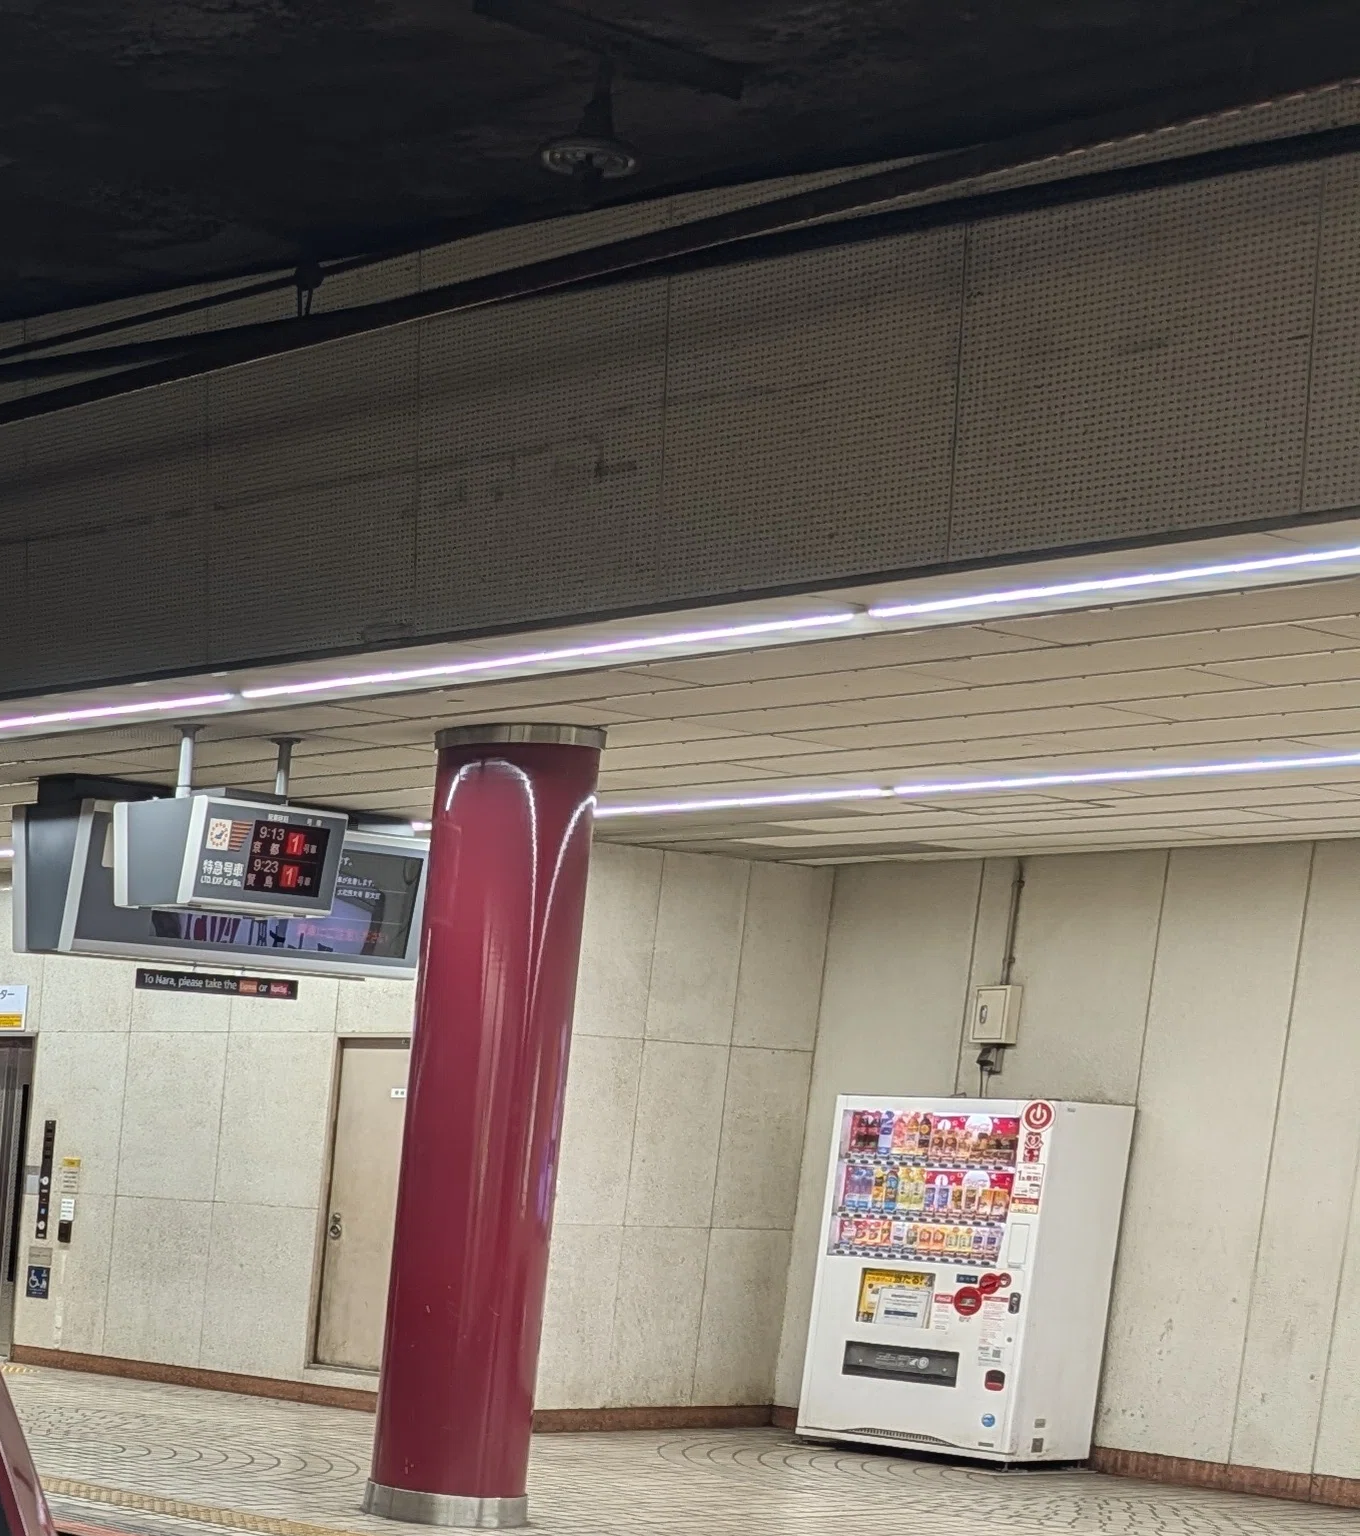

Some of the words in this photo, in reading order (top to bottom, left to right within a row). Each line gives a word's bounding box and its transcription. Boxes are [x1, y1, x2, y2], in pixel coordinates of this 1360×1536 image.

[260, 826, 285, 841] 9:13
[202, 859, 244, 877] 特急号車
[253, 859, 279, 873] 9:23
[144, 973, 154, 984] To
[155, 974, 176, 987] Nara,
[178, 977, 203, 989] please
[205, 979, 223, 989] take
[224, 979, 237, 990] the
[259, 984, 268, 992] or
